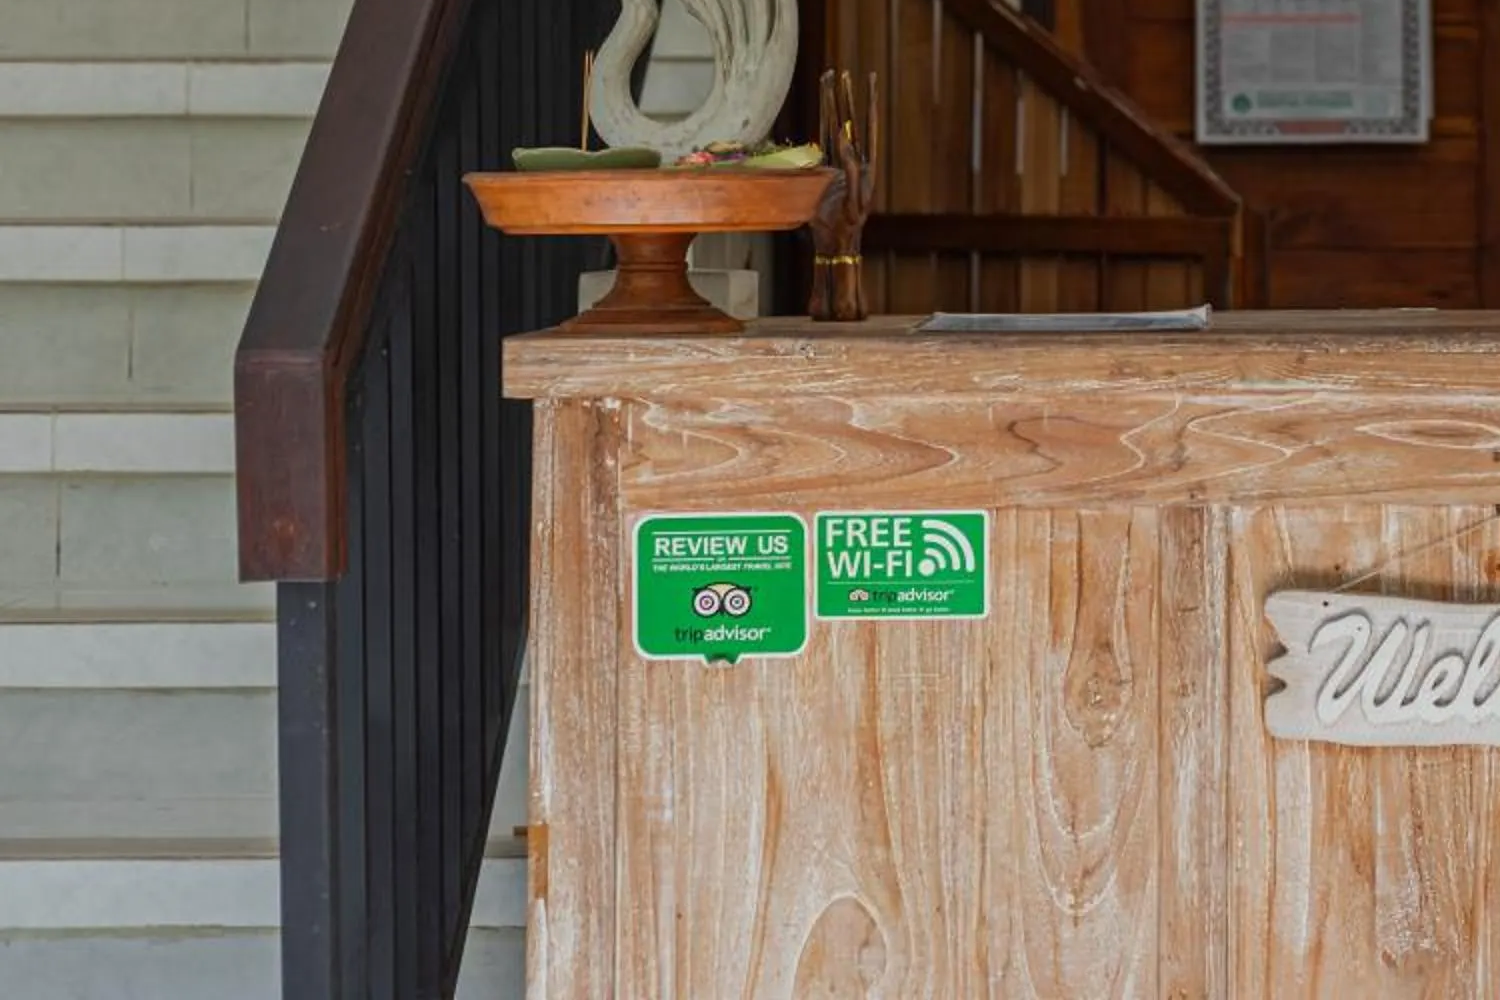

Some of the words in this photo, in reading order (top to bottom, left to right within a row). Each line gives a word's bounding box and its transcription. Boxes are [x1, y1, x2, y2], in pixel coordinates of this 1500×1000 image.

[825, 517, 912, 547] FREE
[655, 535, 748, 556] REVIEW
[758, 535, 788, 555] US
[826, 550, 913, 578] WI-FI
[872, 587, 950, 603] tripadvisor
[674, 624, 765, 644] tripadvisor
